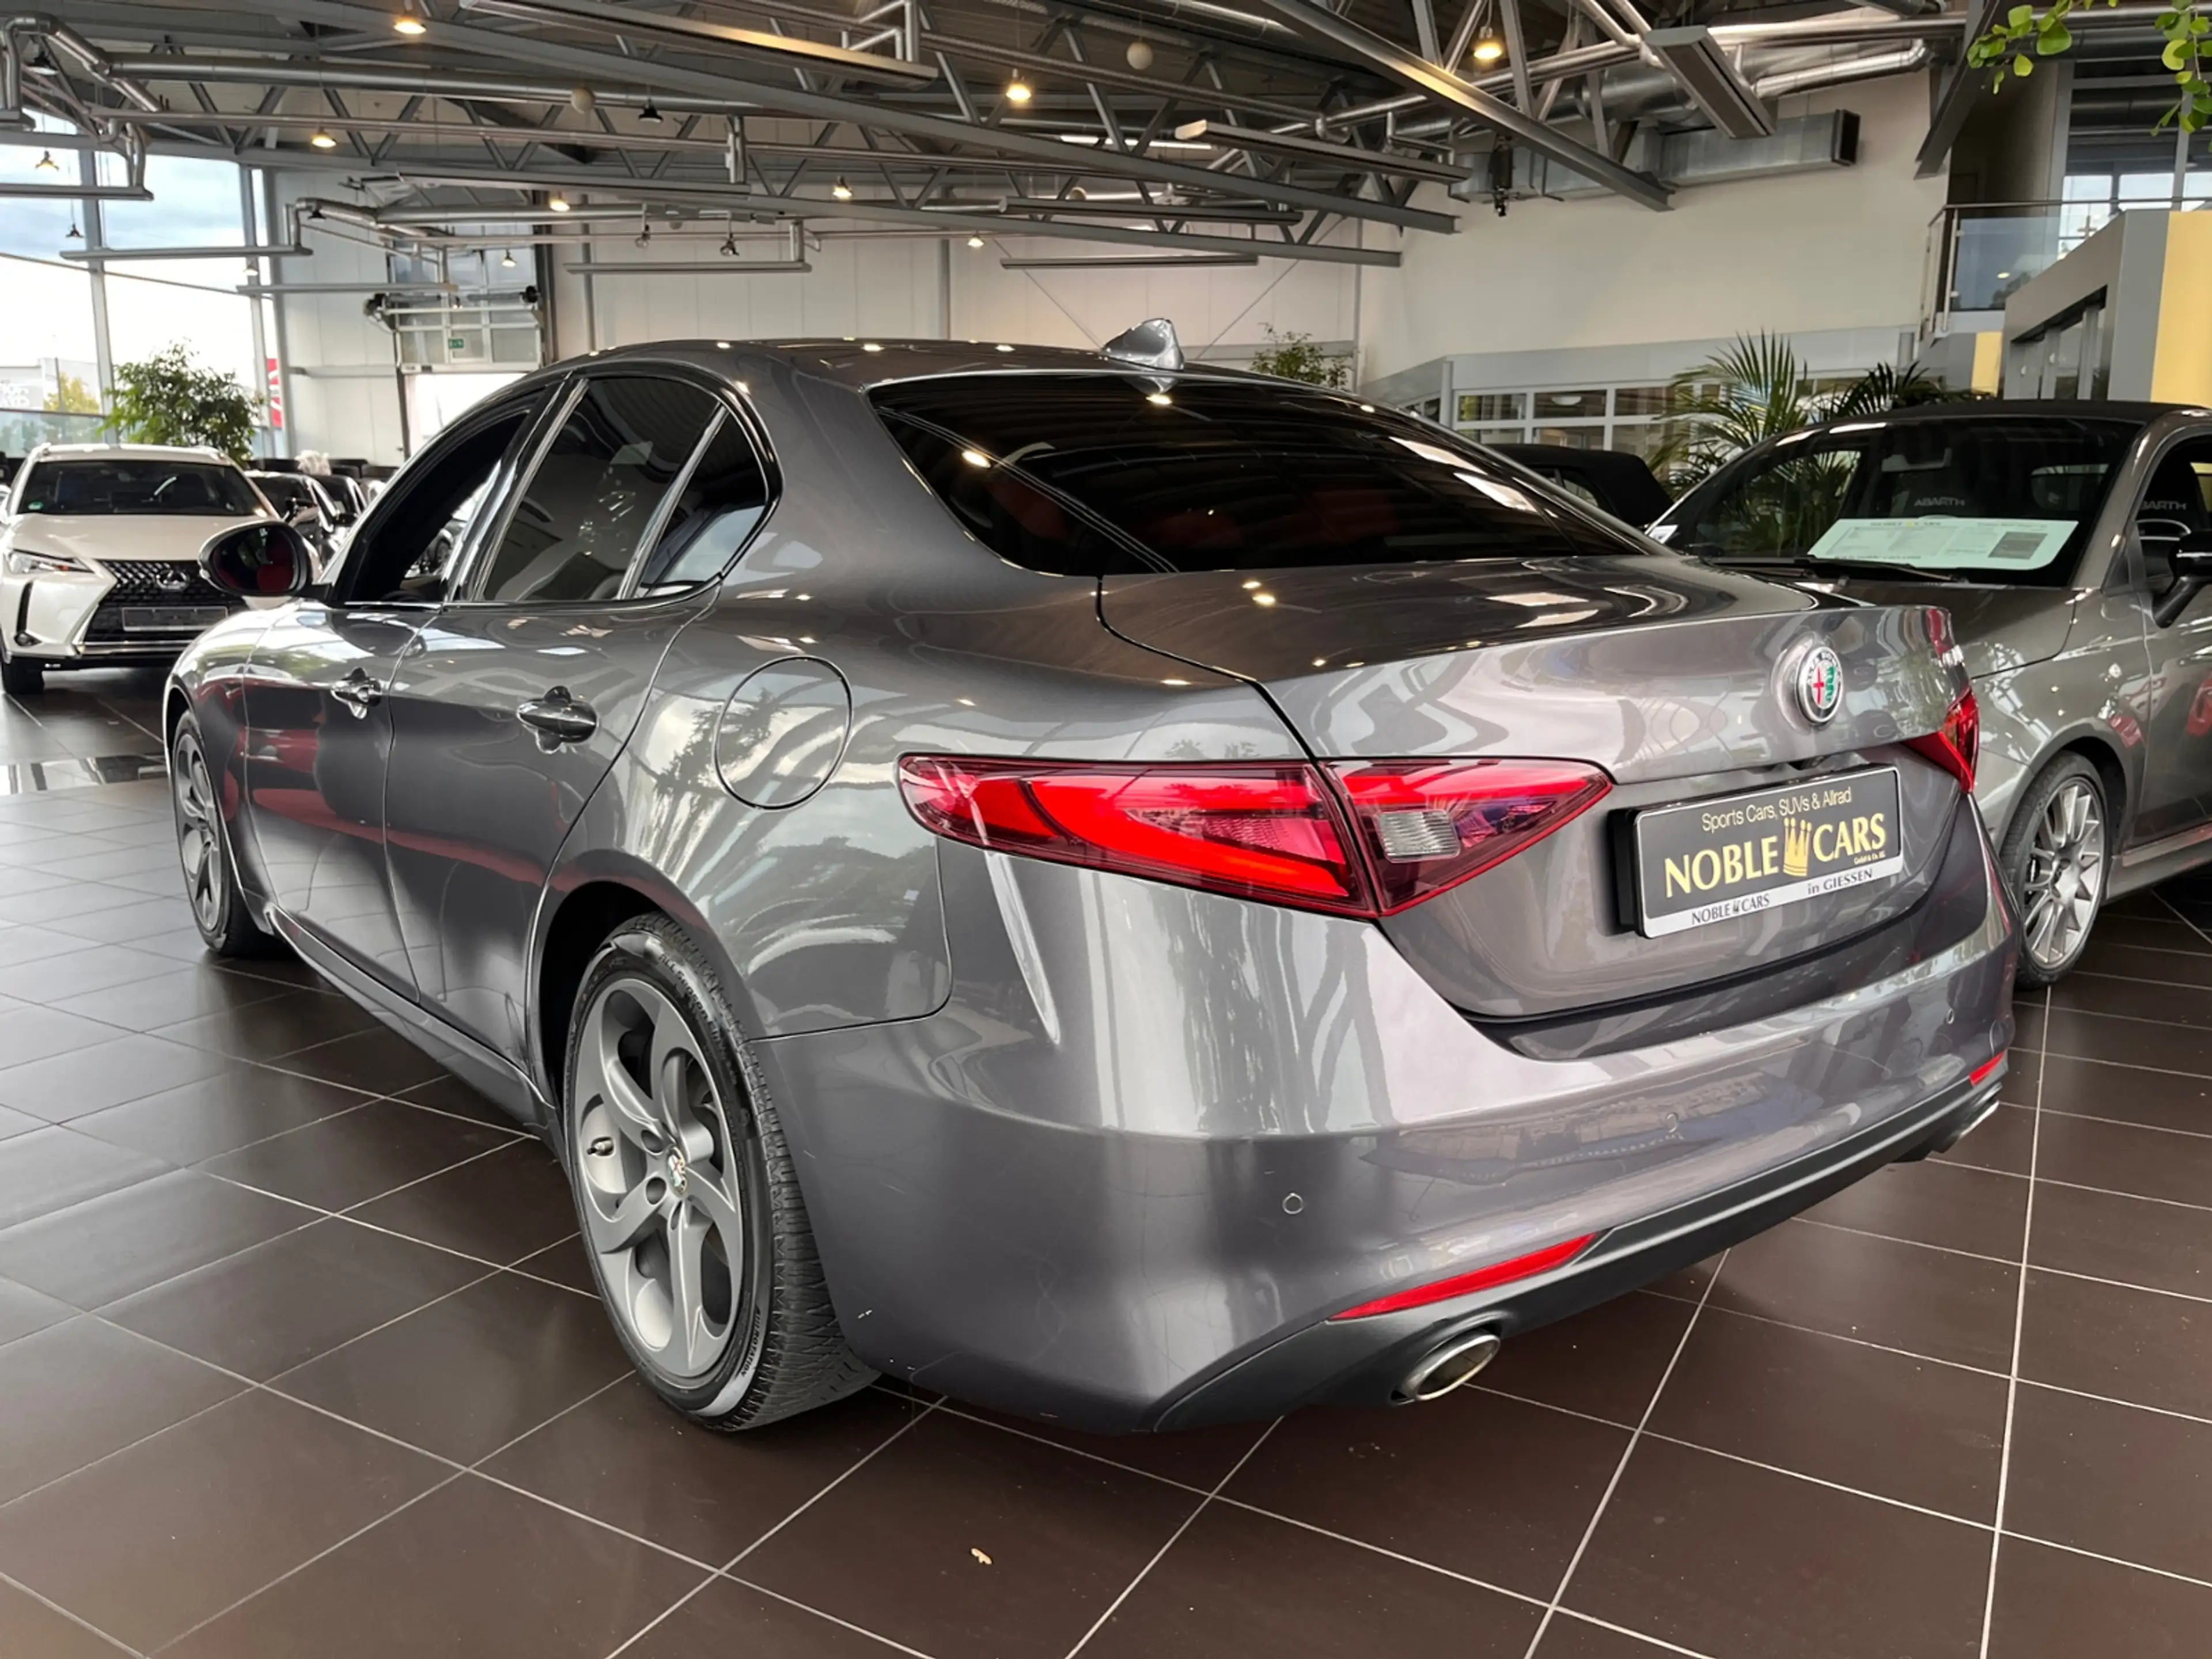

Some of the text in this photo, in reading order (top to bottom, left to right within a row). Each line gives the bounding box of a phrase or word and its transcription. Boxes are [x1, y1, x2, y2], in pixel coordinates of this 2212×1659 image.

[1701, 786, 1853, 834] Sports Cars, SUVs & Allrad
[1664, 812, 1886, 898] NOBLE CARS
[1691, 867, 1873, 925] NOBLE CARS in GIESSEN
